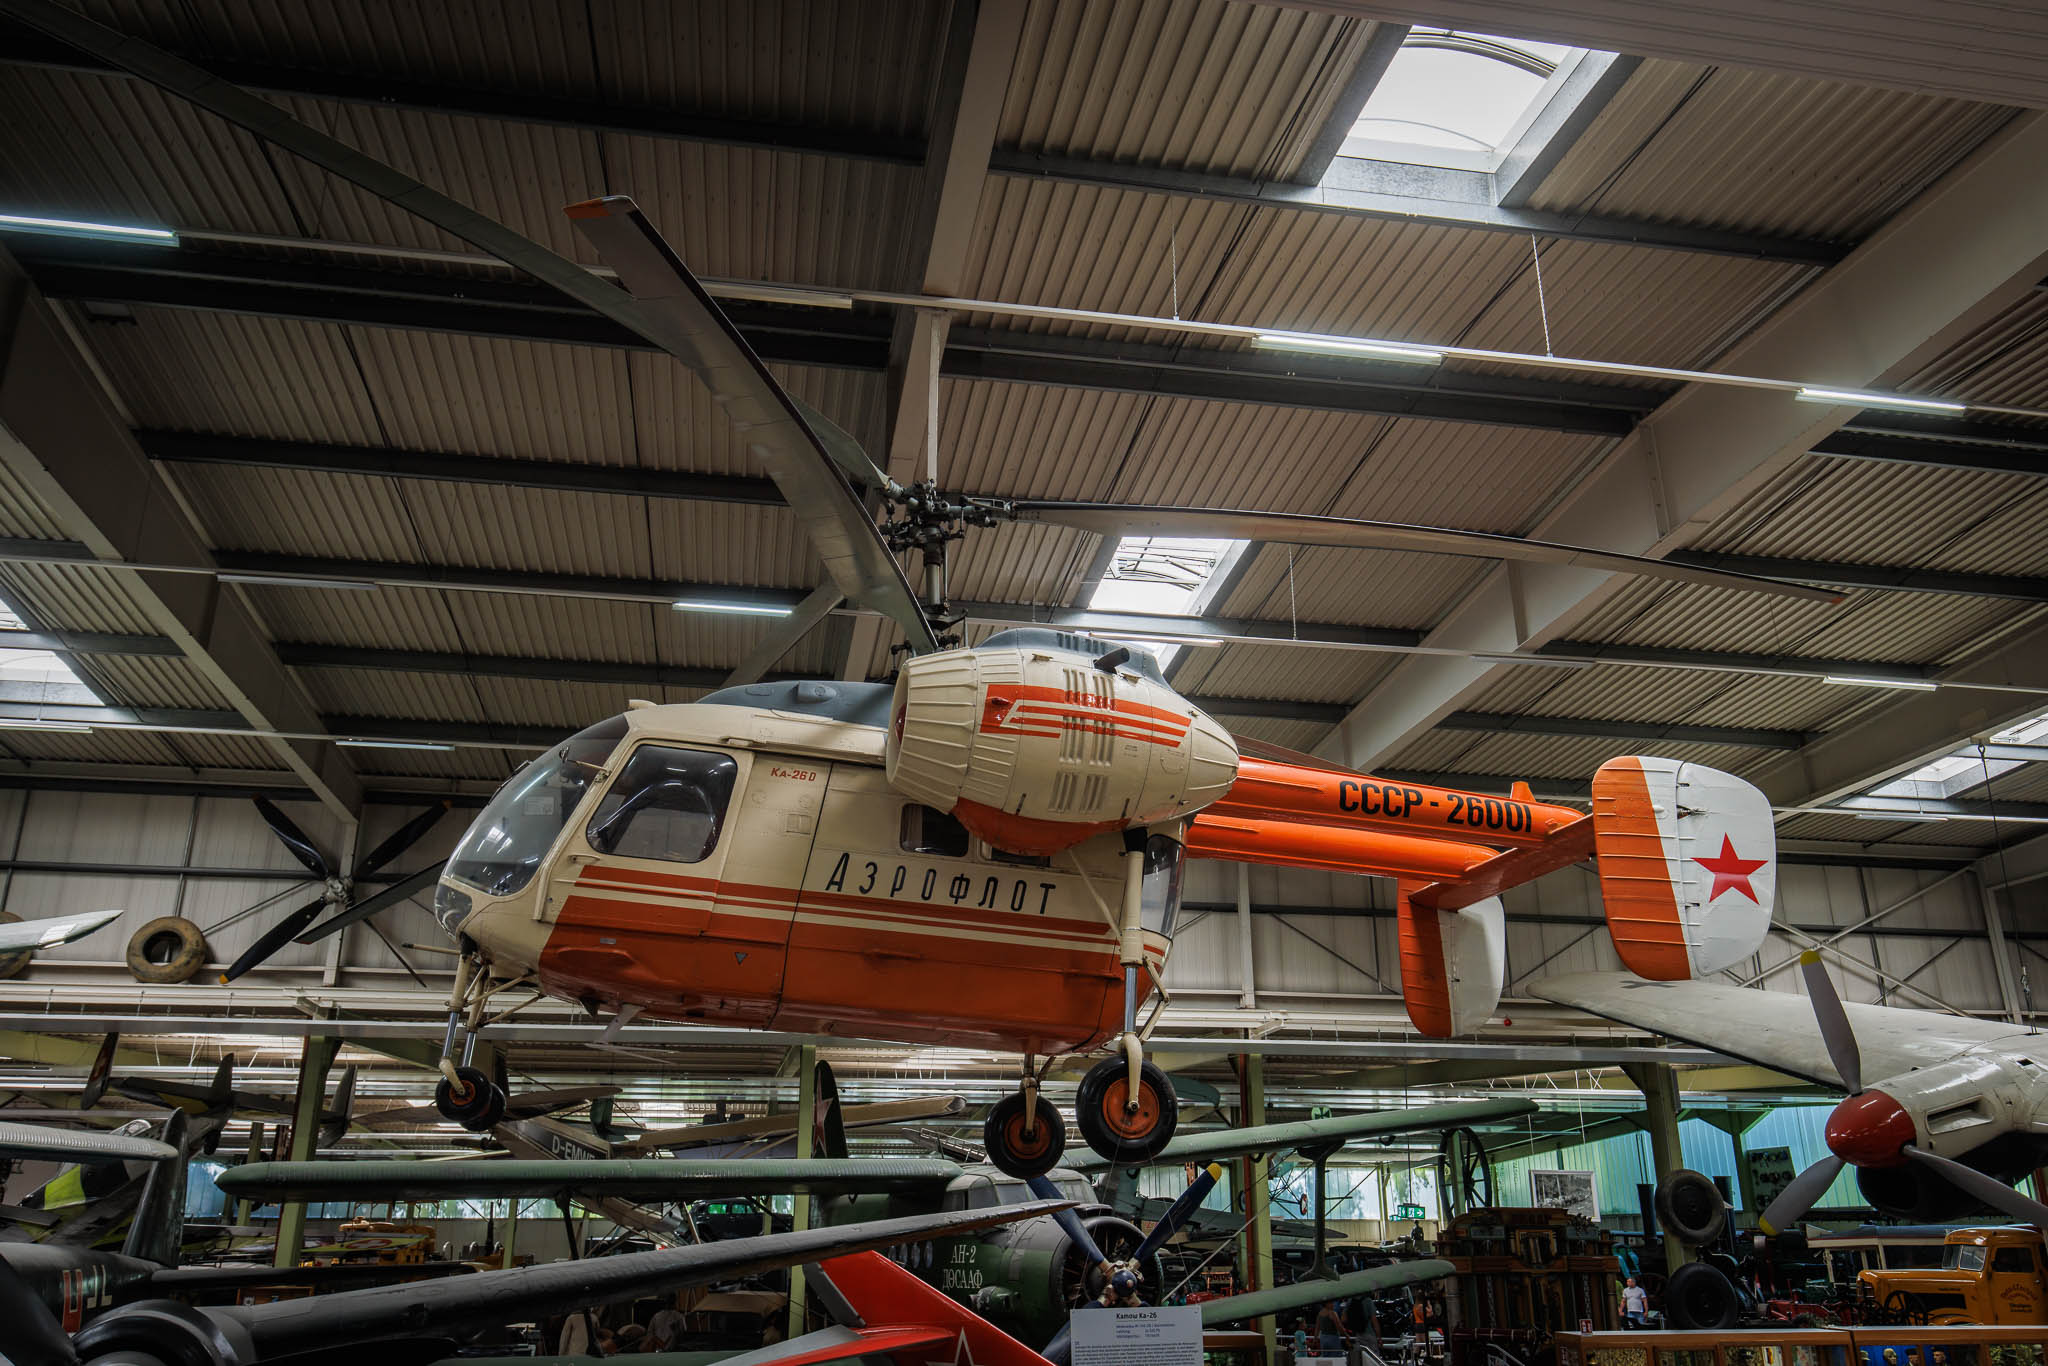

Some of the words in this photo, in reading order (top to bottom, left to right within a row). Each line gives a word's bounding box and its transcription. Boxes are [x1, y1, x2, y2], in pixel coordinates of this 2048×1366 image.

[1447, 794, 1532, 833] 26001
[950, 1244, 977, 1264] АН-2
[1139, 1311, 1157, 1319] Ka-26
